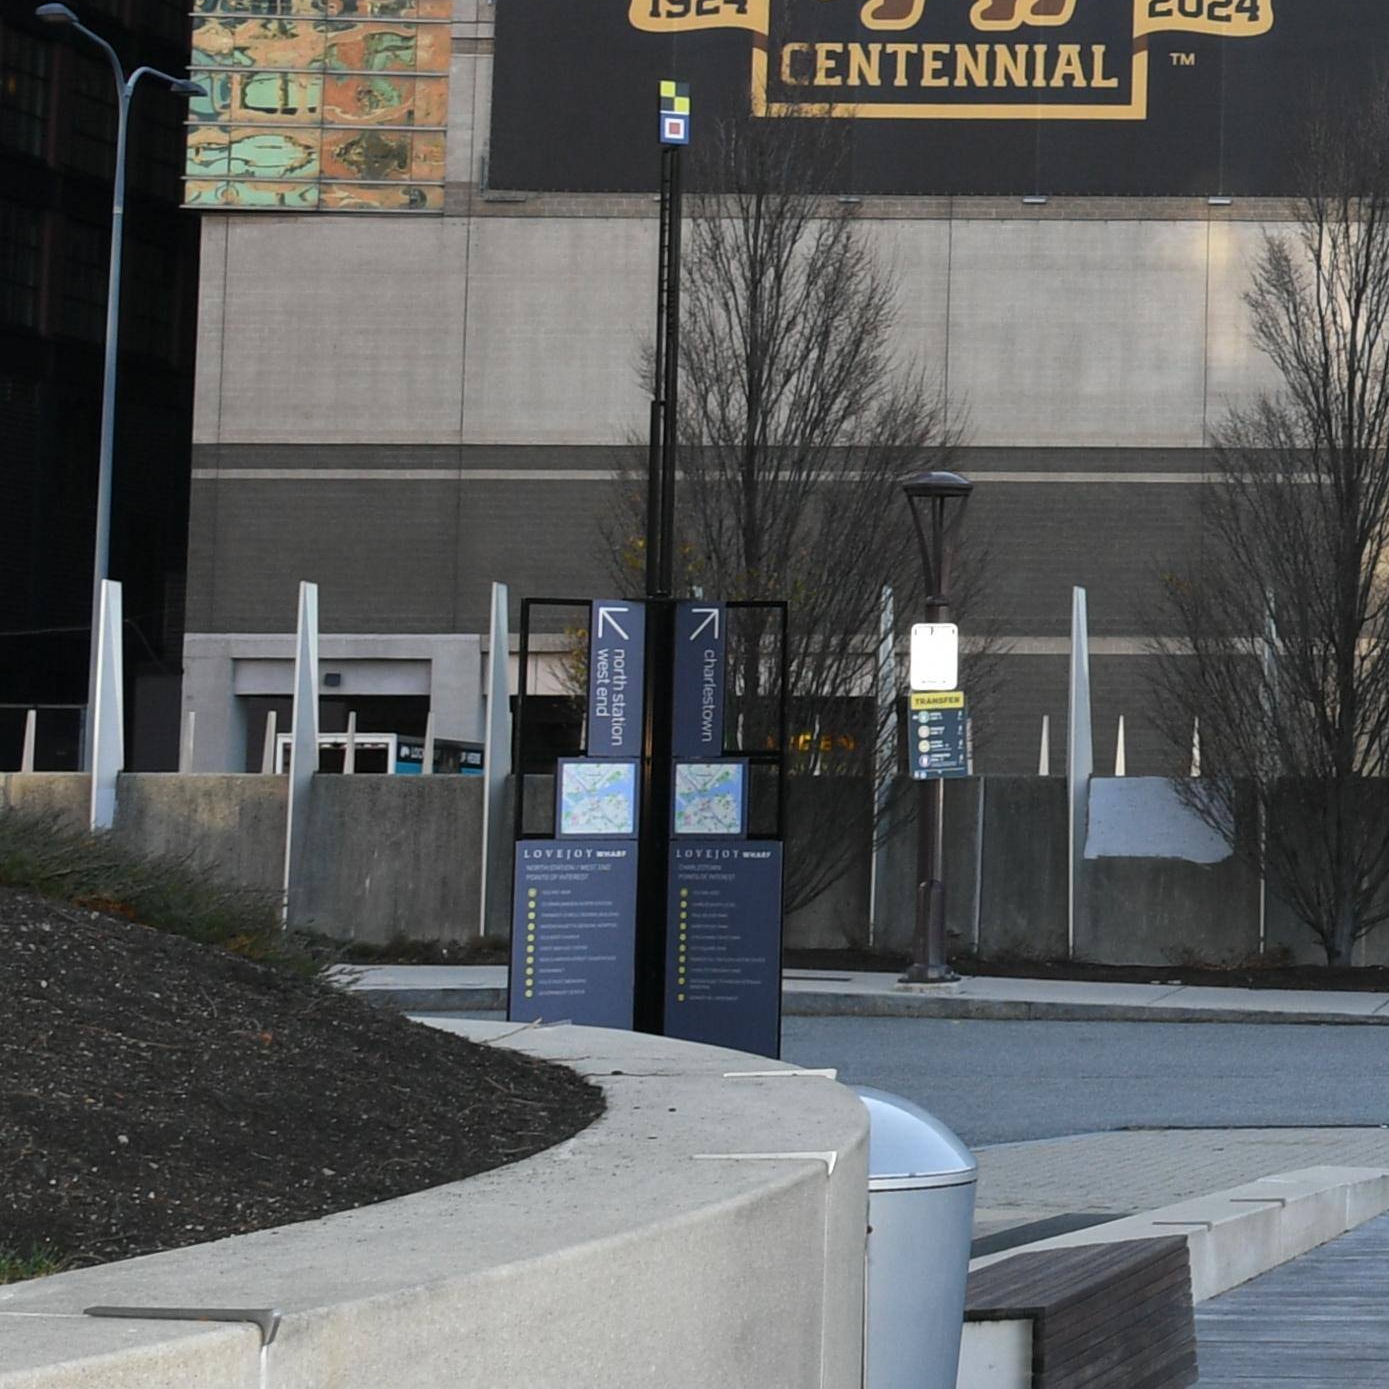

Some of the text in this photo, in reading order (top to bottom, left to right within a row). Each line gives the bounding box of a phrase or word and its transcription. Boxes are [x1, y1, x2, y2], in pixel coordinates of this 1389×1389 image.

[781, 43, 1119, 88] CENTENNIAL
[596, 648, 610, 717] west end
[611, 648, 628, 746] north station
[702, 649, 718, 742] charlestown
[523, 849, 593, 860] LOVEJOY
[676, 849, 740, 860] LOVEJOY
